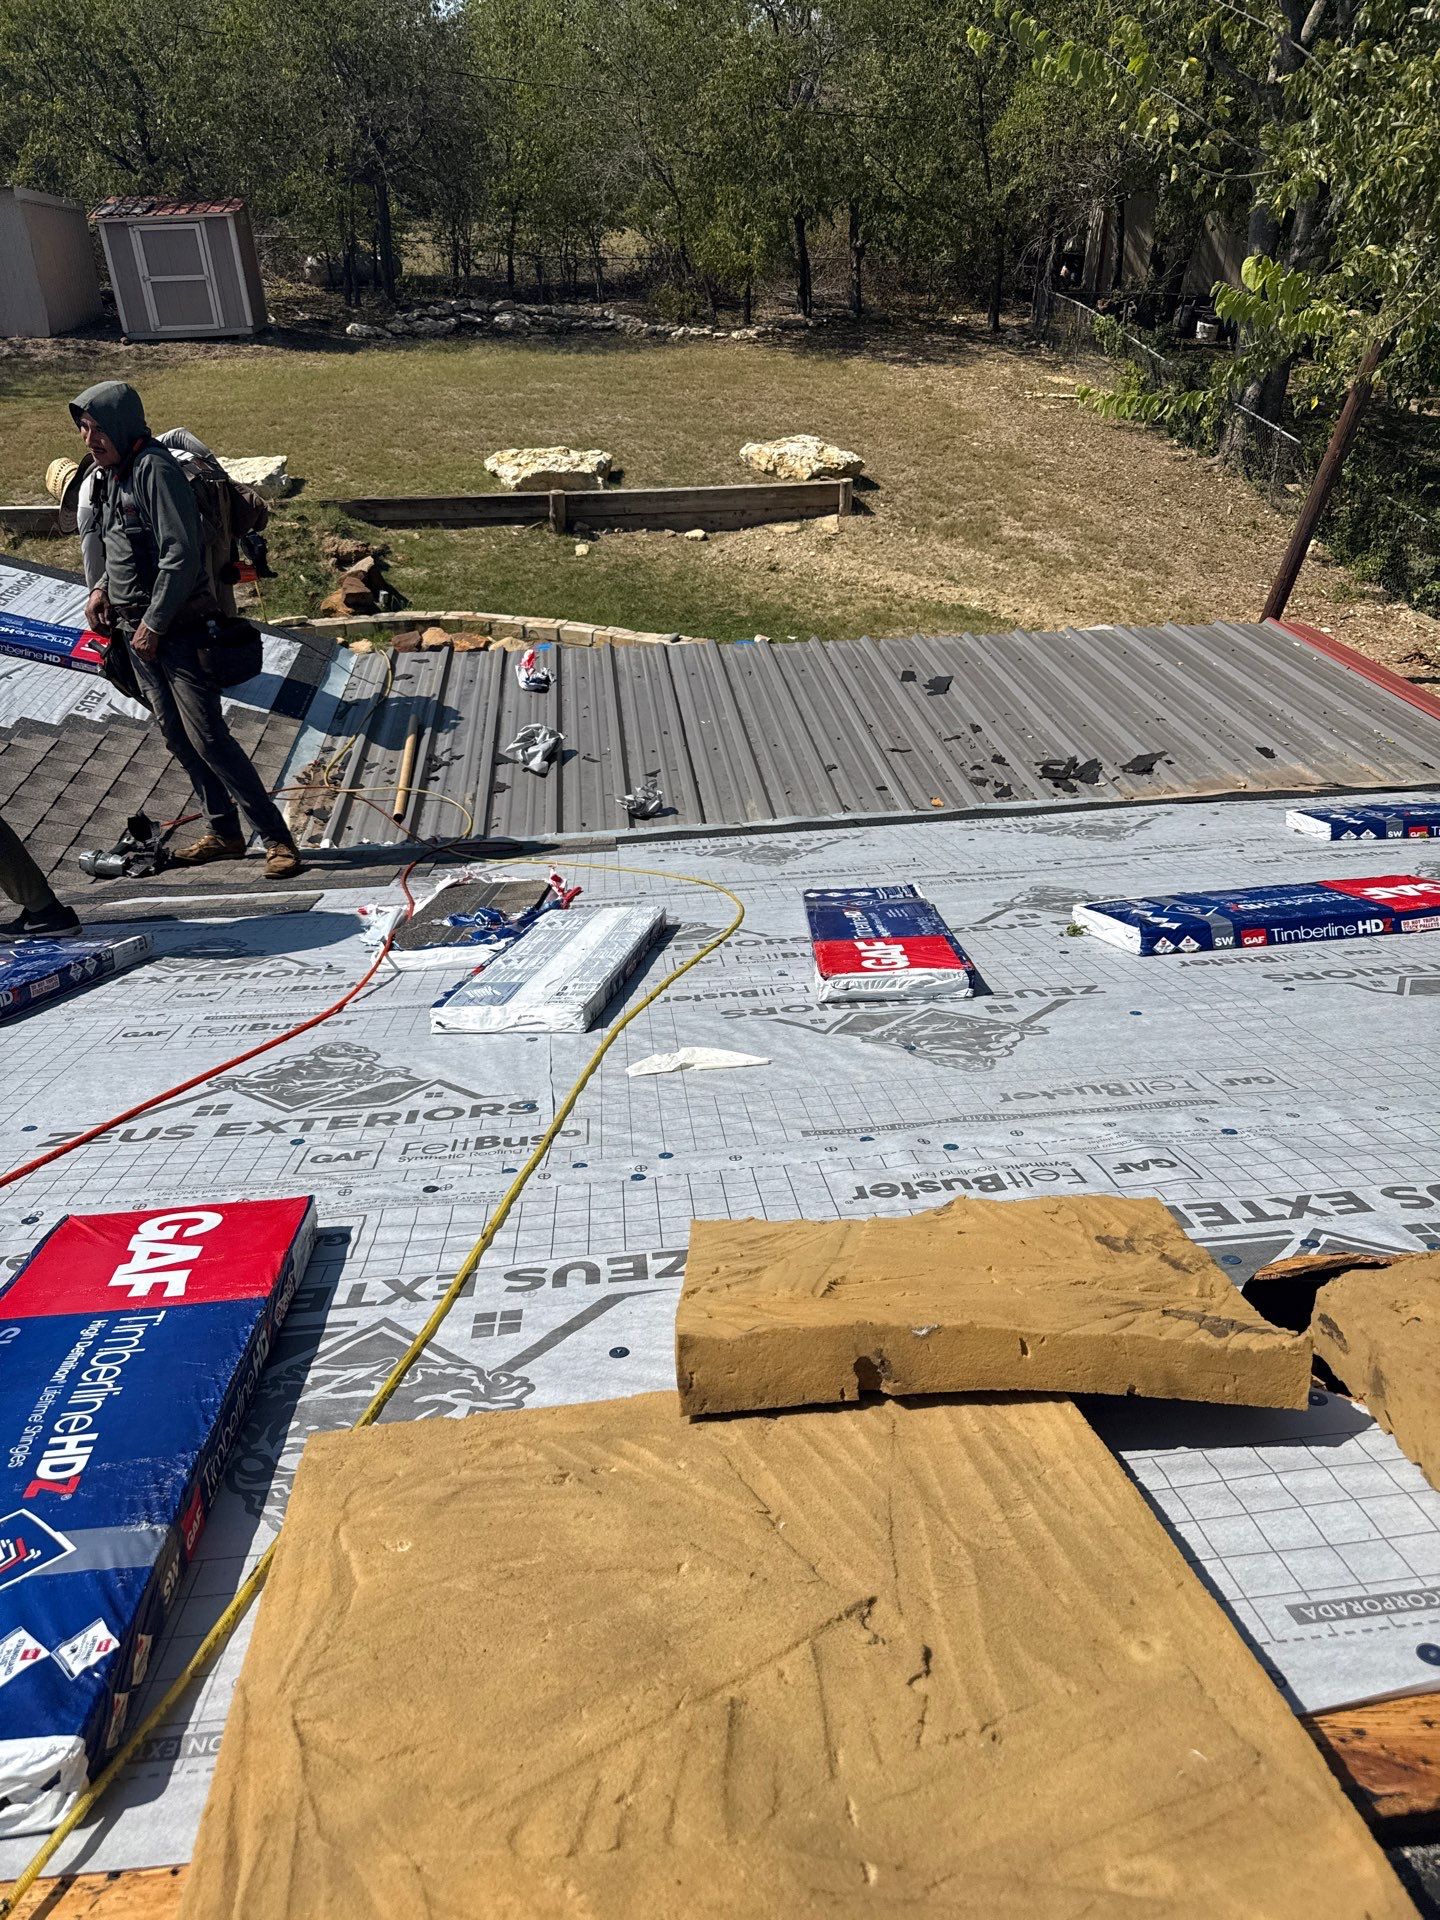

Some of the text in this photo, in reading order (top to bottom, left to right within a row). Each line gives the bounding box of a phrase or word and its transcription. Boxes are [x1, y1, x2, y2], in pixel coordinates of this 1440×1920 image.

[75, 689, 107, 713] ZEUS
[1214, 936, 1234, 947] SW
[1243, 935, 1265, 945] GAF
[854, 941, 911, 970] GAF
[116, 968, 347, 985] EXTERIORS
[660, 984, 810, 1003] FeltBuster
[992, 985, 1107, 1000] ZEUS
[998, 1075, 1276, 1103] GAF FeltBuster
[213, 1101, 540, 1138] EXTERIORS
[310, 1150, 374, 1163] GAF
[401, 1134, 547, 1156] FeltBus
[398, 1152, 466, 1163] Synthetic
[911, 1171, 937, 1181] Felt
[1000, 1160, 1072, 1172] Synthetic
[1111, 1158, 1178, 1175] GAF
[107, 1211, 224, 1297] GAF
[503, 1249, 689, 1293] ZEUS
[80, 1319, 110, 1340] High
[7, 1425, 39, 1468] Shingles
[186, 1504, 202, 1551] GAF
[1299, 1591, 1440, 1620] CORPORADA
